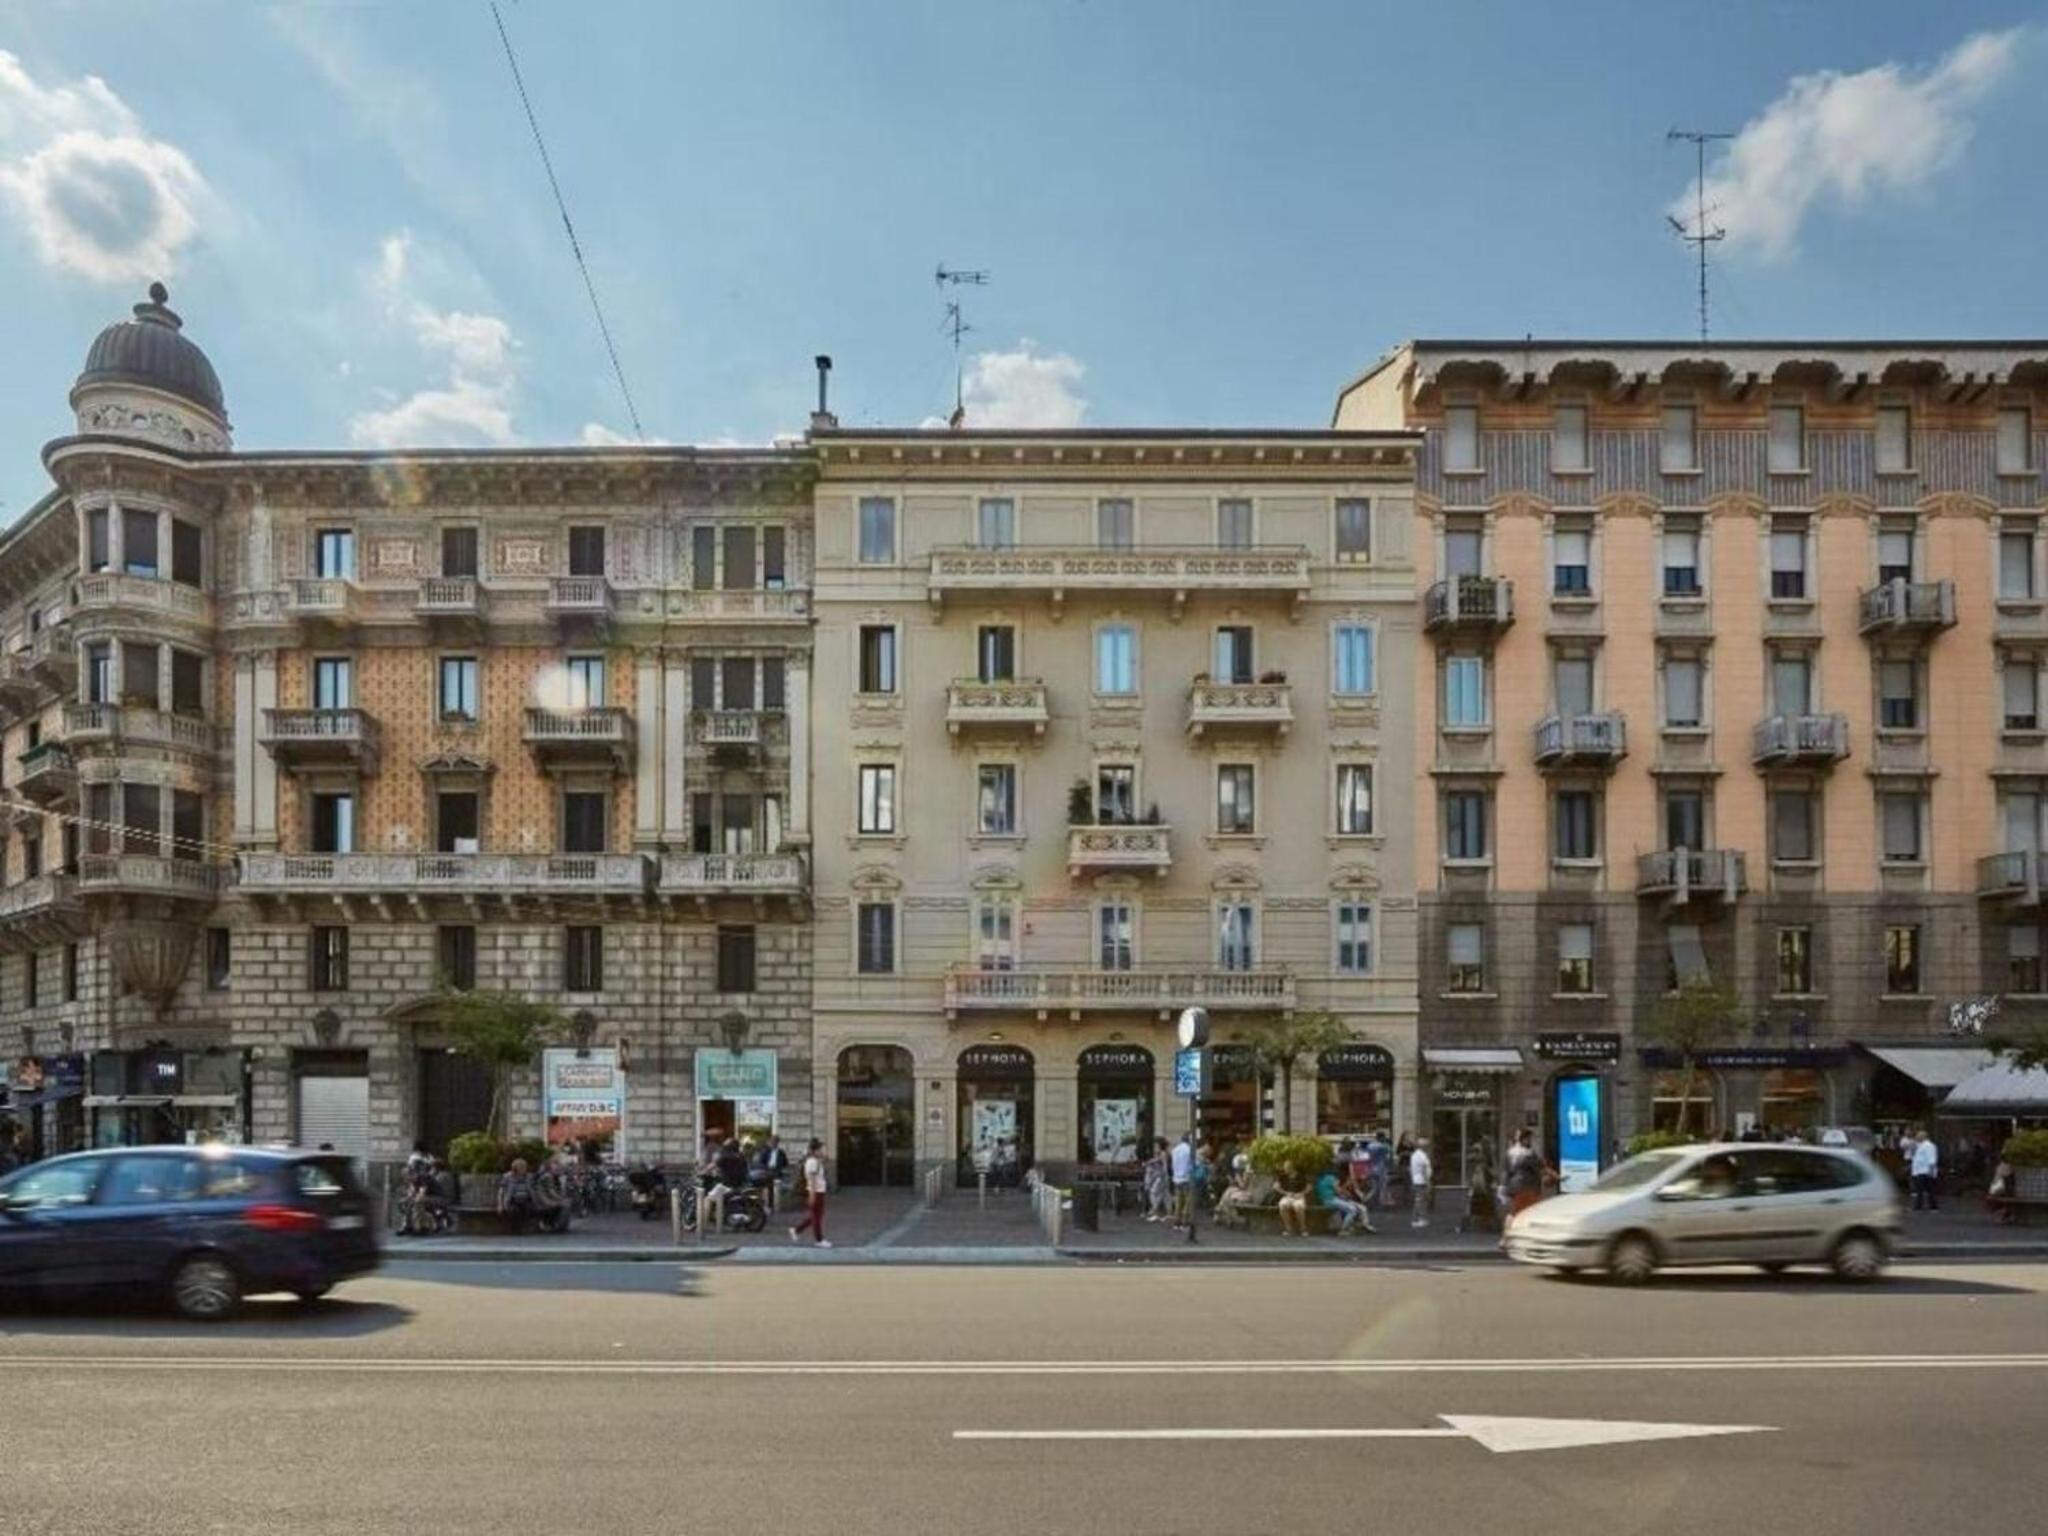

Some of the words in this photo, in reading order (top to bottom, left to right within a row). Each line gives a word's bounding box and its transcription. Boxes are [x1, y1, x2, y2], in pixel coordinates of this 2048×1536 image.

[1086, 1052, 1147, 1065] SEPHORA
[157, 1063, 177, 1076] TIM
[1568, 1104, 1589, 1136] tu
